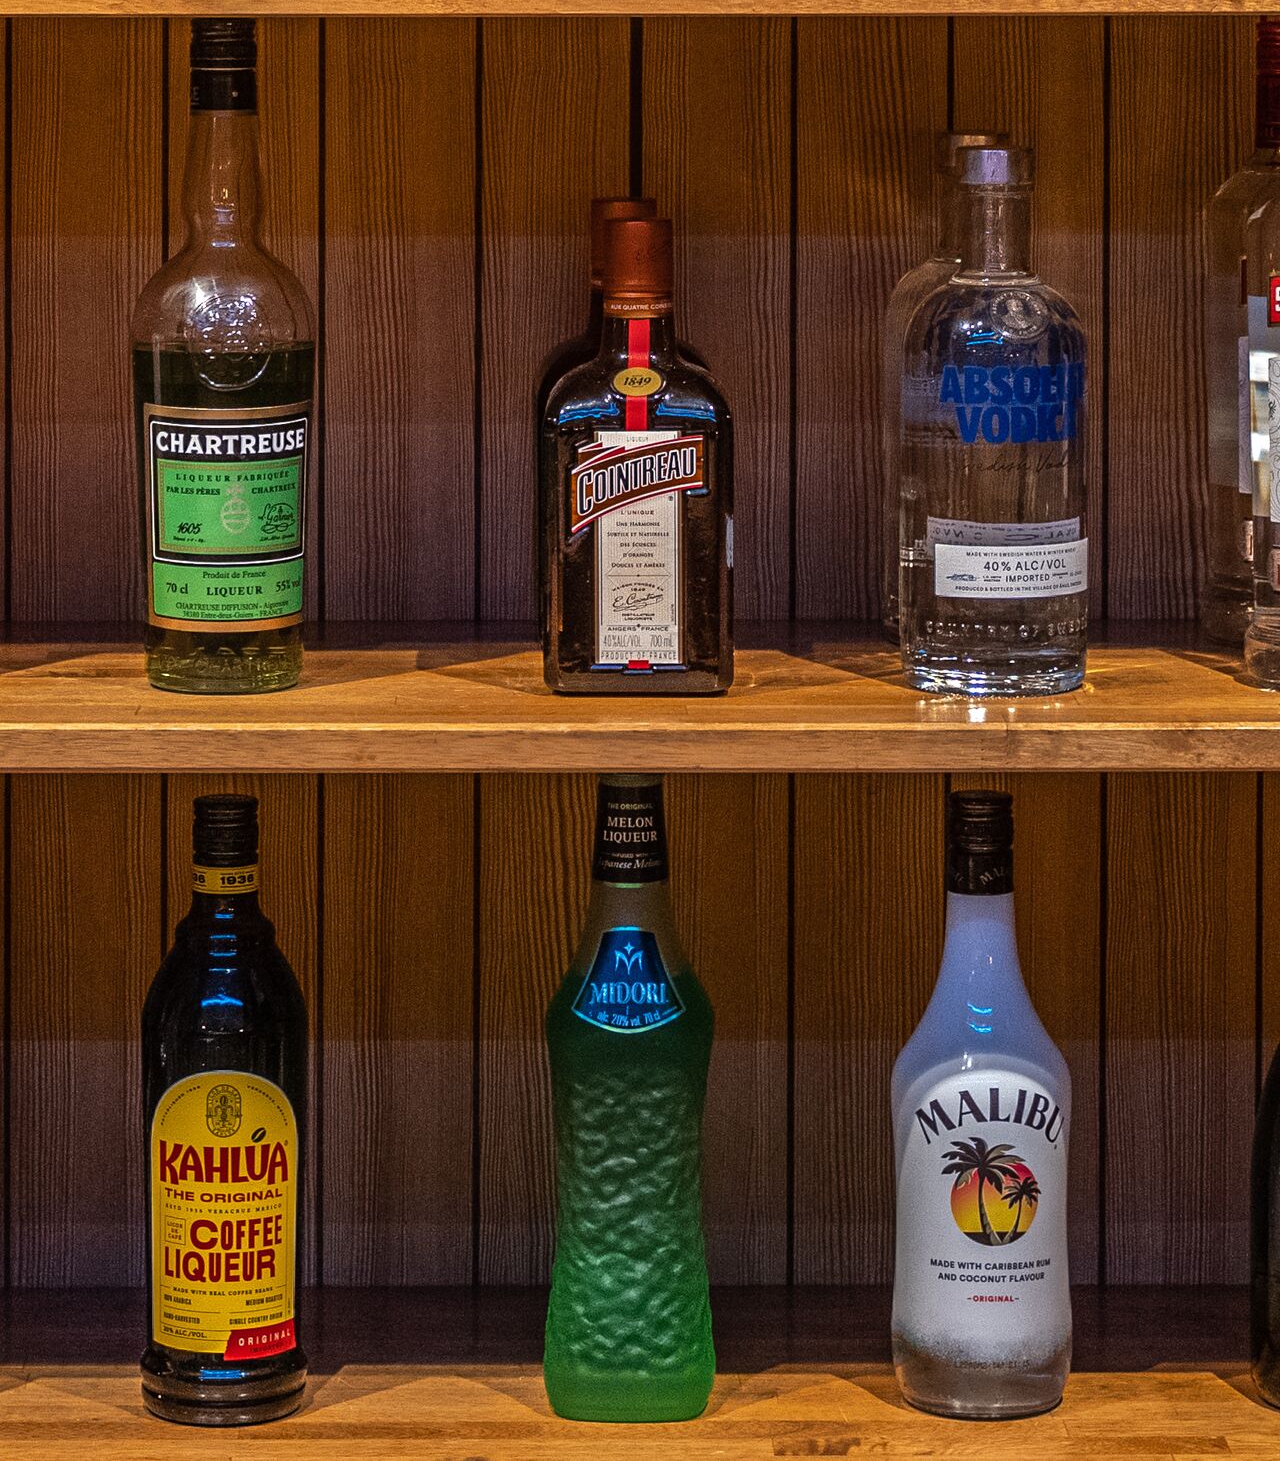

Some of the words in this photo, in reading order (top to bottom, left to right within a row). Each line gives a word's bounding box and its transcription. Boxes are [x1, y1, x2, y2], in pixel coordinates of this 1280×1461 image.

[623, 376, 652, 387] 1849
[156, 429, 305, 455] CHARTREUSE
[577, 447, 696, 515] COINTREAU
[1005, 573, 1050, 583] IMPORTED
[207, 585, 263, 596] LIQUEUR
[608, 816, 653, 828] MELON
[603, 830, 658, 843] LIQUEUR
[915, 1088, 1065, 1144] MALIBU
[164, 1187, 195, 1201] THE
[200, 1188, 283, 1203] ORIGINAL
[190, 1214, 283, 1251] COFFEE
[164, 1245, 276, 1283] LIQUEUR
